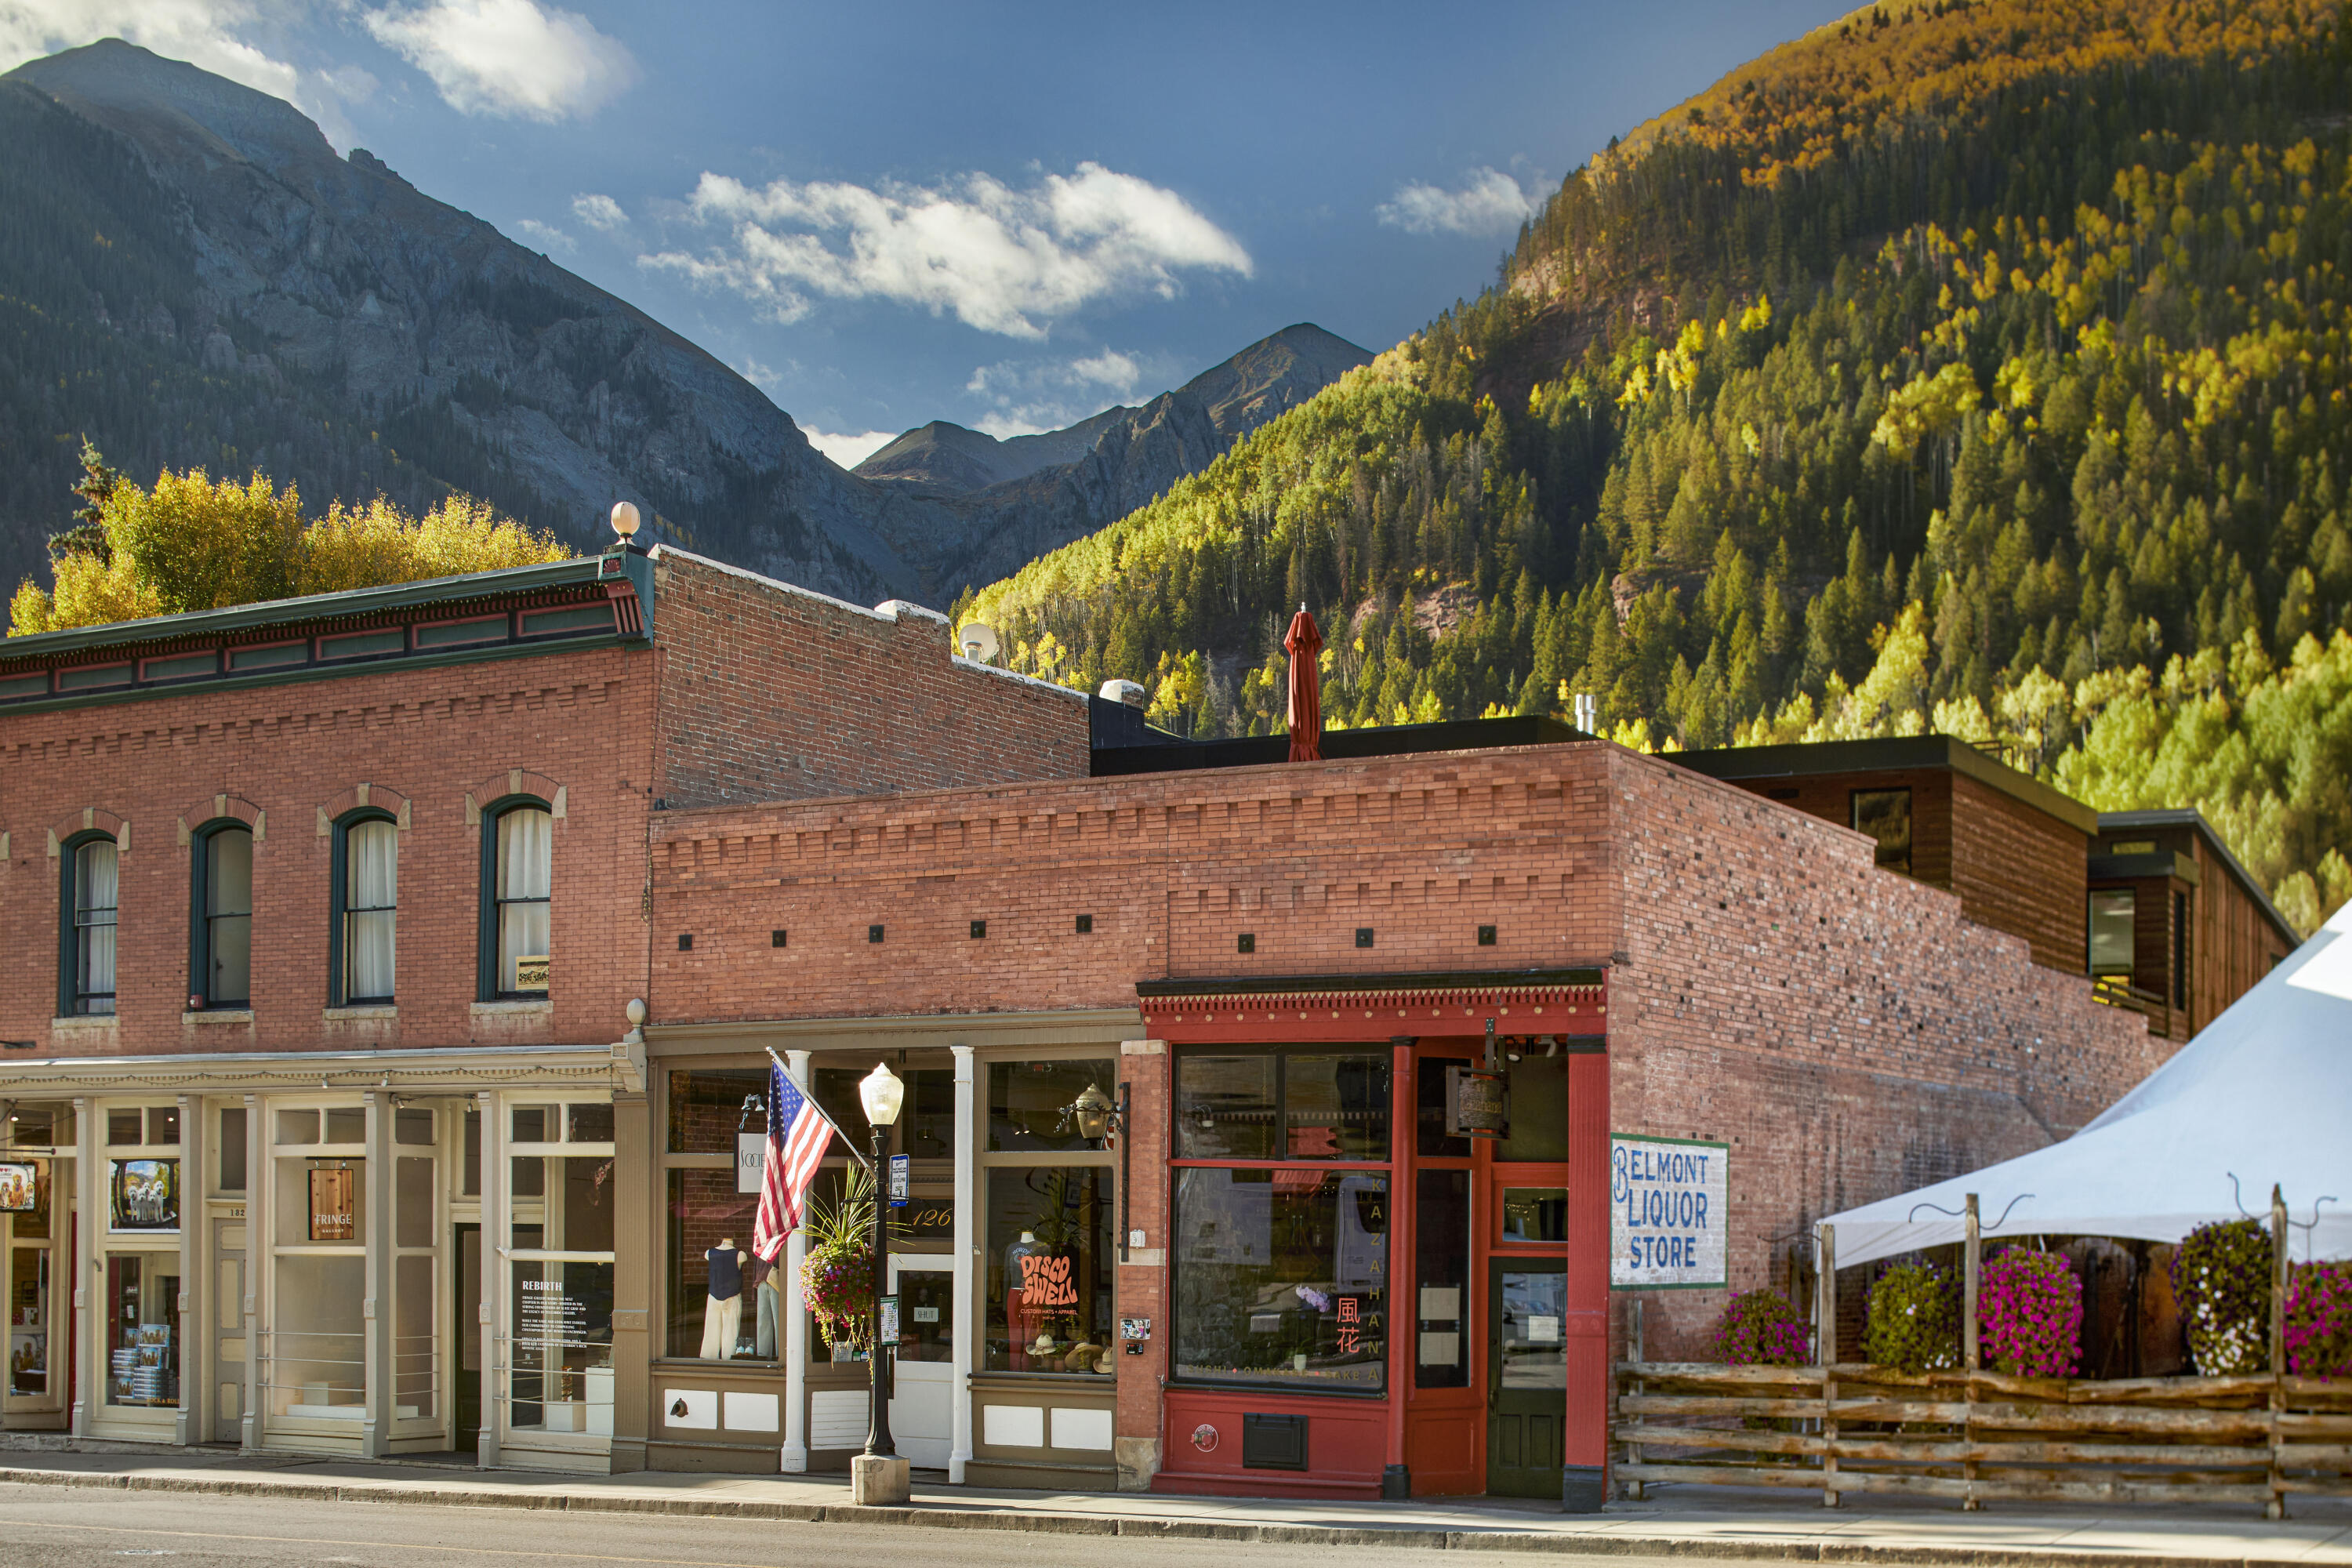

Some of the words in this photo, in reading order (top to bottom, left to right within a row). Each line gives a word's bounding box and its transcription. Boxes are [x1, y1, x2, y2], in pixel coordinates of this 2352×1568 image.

[1613, 1146, 1709, 1203] BELMONT
[315, 1214, 352, 1225] FRINGE
[913, 1208, 953, 1226] 126
[1628, 1189, 1708, 1229] LIQUOR
[1630, 1236, 1696, 1269] STORE
[1020, 1255, 1070, 1283] DISCO
[522, 1280, 562, 1291] REBIRTH
[1022, 1273, 1078, 1305] SWELL
[1337, 1298, 1360, 1353] 風花
[1188, 1364, 1227, 1374] SUSHI
[1326, 1370, 1360, 1381] SAKE
